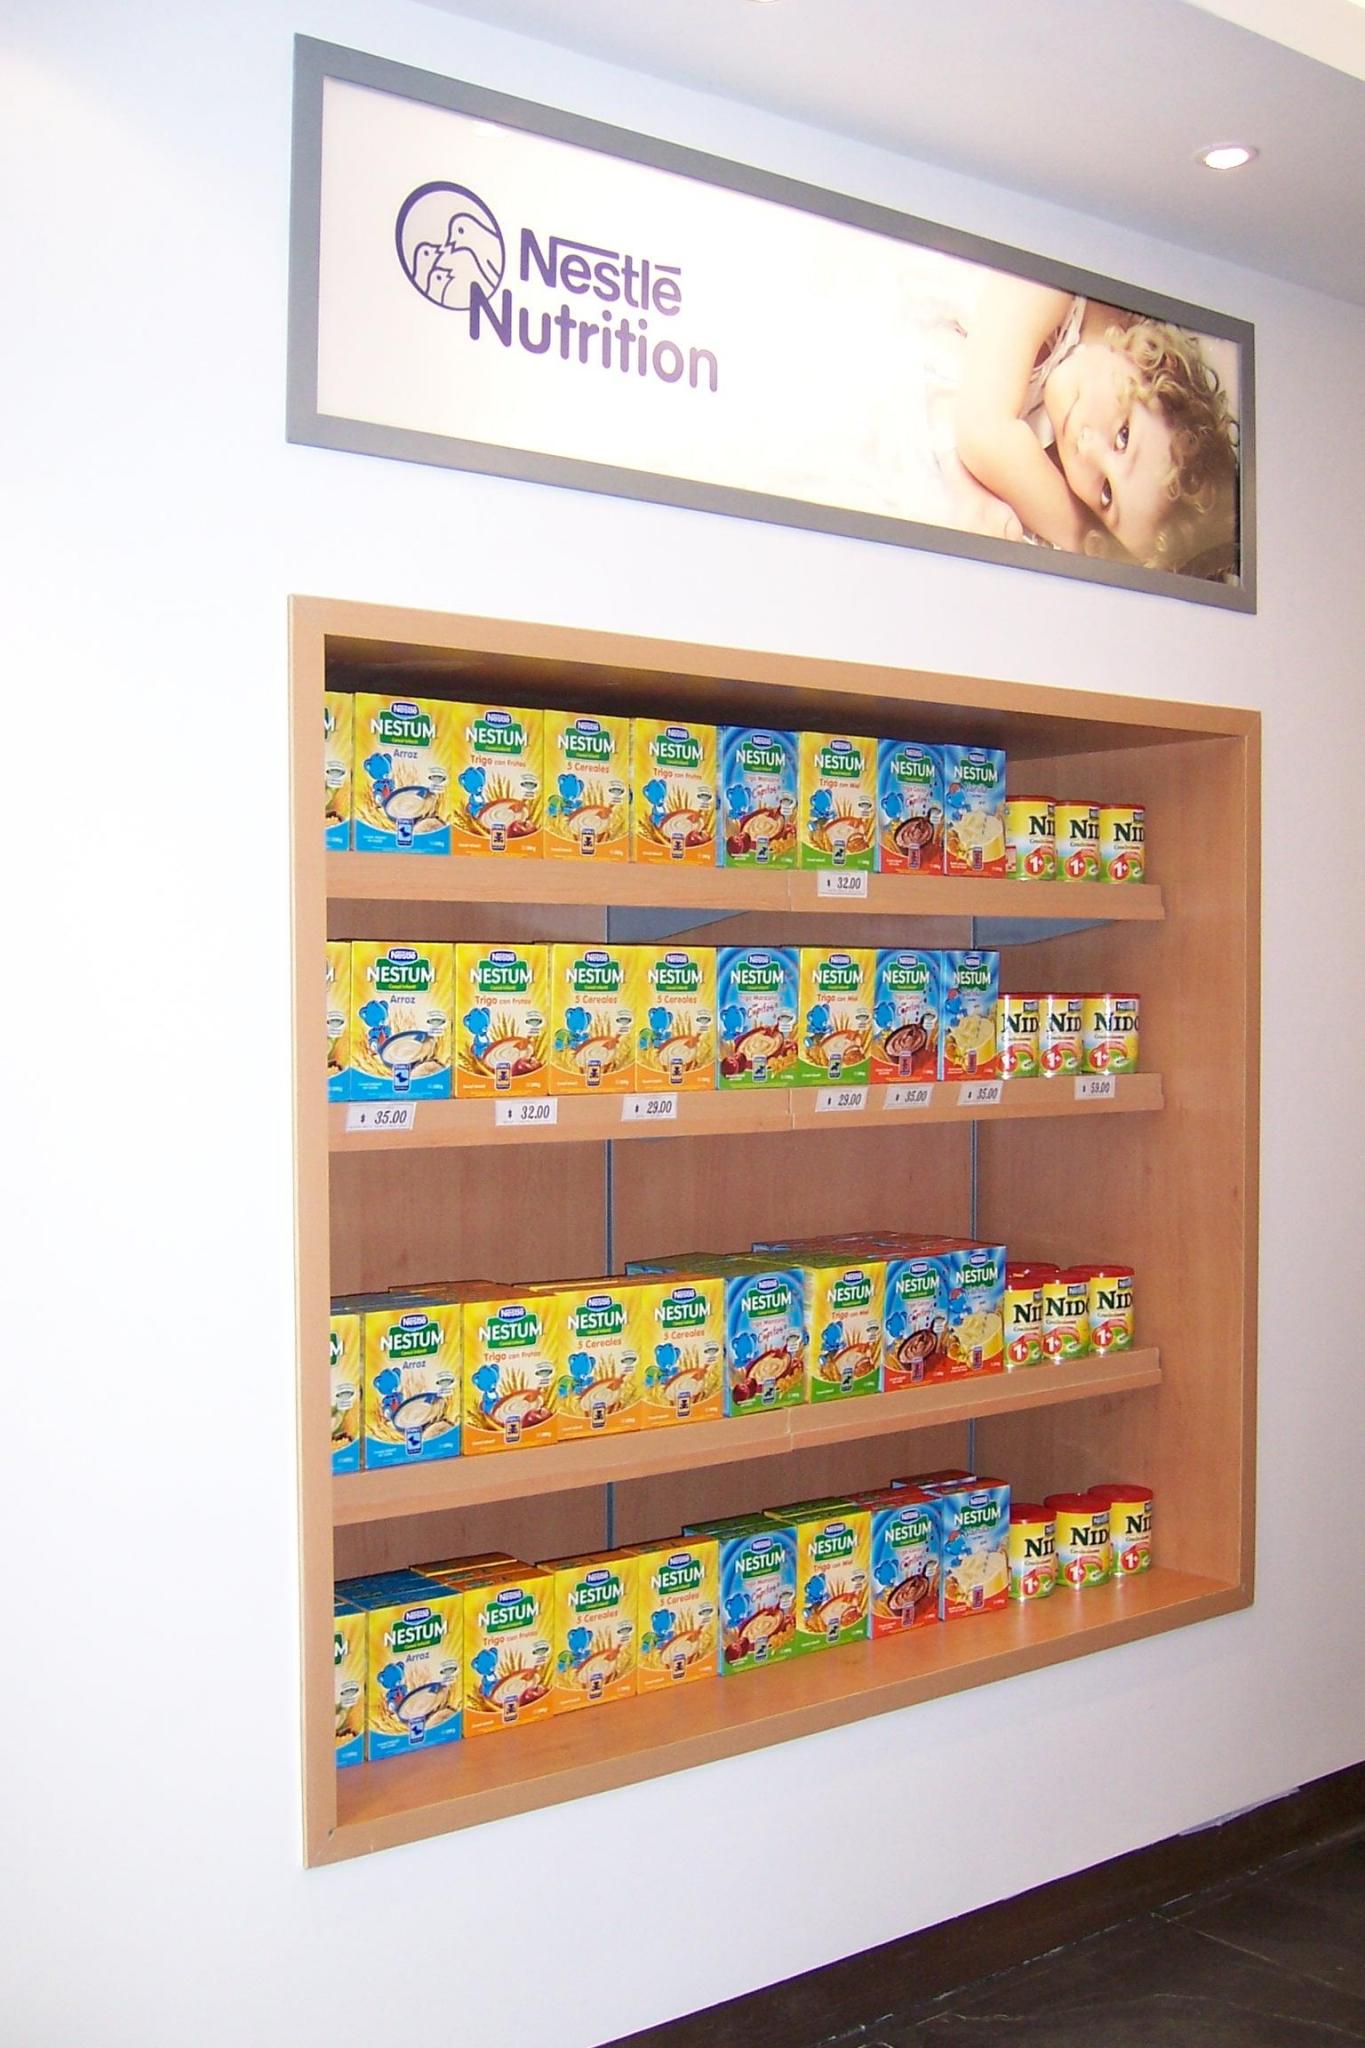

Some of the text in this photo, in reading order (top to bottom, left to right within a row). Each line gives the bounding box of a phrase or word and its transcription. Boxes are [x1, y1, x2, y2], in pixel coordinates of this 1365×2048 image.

[469, 281, 717, 392] Nutrition
[371, 718, 437, 738] NESTUM
[466, 727, 528, 746] NESTUM
[558, 735, 616, 753] NESTUM
[649, 742, 703, 760] NESTUM
[393, 749, 418, 759] Arroz
[471, 755, 492, 767] Trigo
[736, 750, 785, 766] NESTUM
[575, 763, 609, 773] Cereales
[814, 755, 865, 771] NESTUM
[891, 761, 935, 777] NESTUM
[654, 768, 672, 778] Trigo
[954, 766, 997, 782] NESTUM
[819, 779, 838, 788] Trigo
[837, 878, 861, 889] 32.00
[367, 967, 435, 982] NESTUM
[470, 969, 533, 983] NESTUM
[566, 969, 624, 984] NESTUM
[648, 969, 703, 984] NESTUM
[731, 970, 783, 984] NESTUM
[812, 970, 863, 983] NESTUM
[883, 971, 929, 984] NESTUM
[954, 971, 990, 984] NESTUM
[391, 995, 415, 1004] Arroz
[475, 996, 497, 1005] Trigo
[583, 995, 617, 1004] Cereales
[665, 995, 697, 1004] Cereales
[818, 994, 836, 1002] Trigo
[838, 1093, 862, 1106] 29.00
[521, 1105, 550, 1119] 32.00
[647, 1101, 672, 1114] 29.00
[374, 1110, 407, 1124] 35.00
[956, 1268, 998, 1283] NESTUM
[896, 1276, 940, 1293] NESTUM
[827, 1285, 874, 1302] NESTUM
[741, 1292, 792, 1311] NESTUM
[655, 1304, 711, 1321] NESTUM
[832, 1311, 848, 1320] Trigo
[568, 1311, 627, 1330] NESTUM
[479, 1322, 542, 1341] NESTUM
[671, 1329, 705, 1340] Cereales
[380, 1329, 444, 1350] NESTUM
[586, 1338, 622, 1348] Cereales
[403, 1360, 426, 1370] Arroz
[484, 1353, 506, 1363] Trigo
[954, 1508, 1000, 1526] NESTUM
[885, 1522, 932, 1542] NESTUM
[809, 1535, 858, 1555] NESTUM
[736, 1550, 785, 1573] NESTUM
[814, 1564, 830, 1572] Trigo
[651, 1565, 705, 1589] NESTUM
[568, 1583, 624, 1607] NESTUM
[667, 1592, 699, 1604] Cereales
[478, 1602, 539, 1627] NESTUM
[584, 1610, 618, 1623] Cereales
[384, 1620, 448, 1646] NESTUM
[484, 1636, 505, 1646] Trigo
[406, 1652, 429, 1662] Arroz
